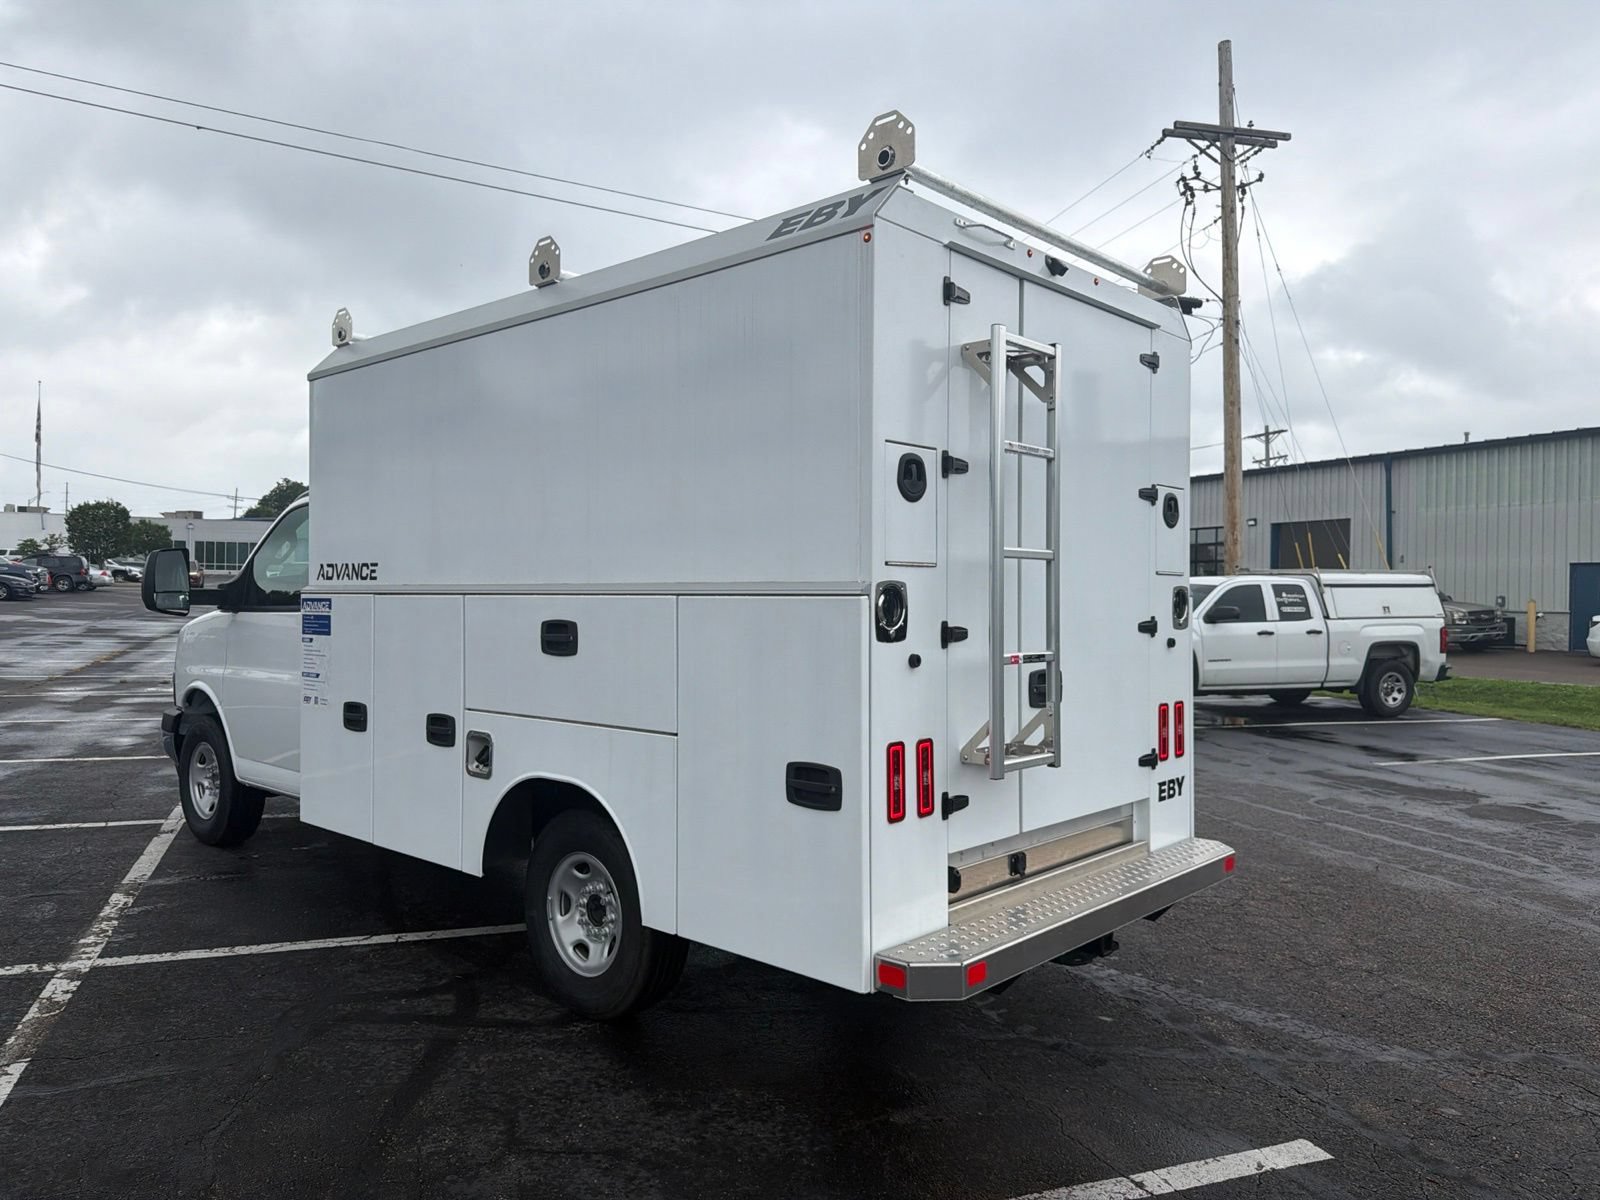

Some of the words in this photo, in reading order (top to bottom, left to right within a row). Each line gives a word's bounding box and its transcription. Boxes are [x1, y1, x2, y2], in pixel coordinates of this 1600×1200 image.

[765, 185, 889, 241] EBY
[316, 562, 378, 581] ADVANCE
[302, 601, 330, 611] ADVANCE
[1158, 775, 1185, 802] EBY
